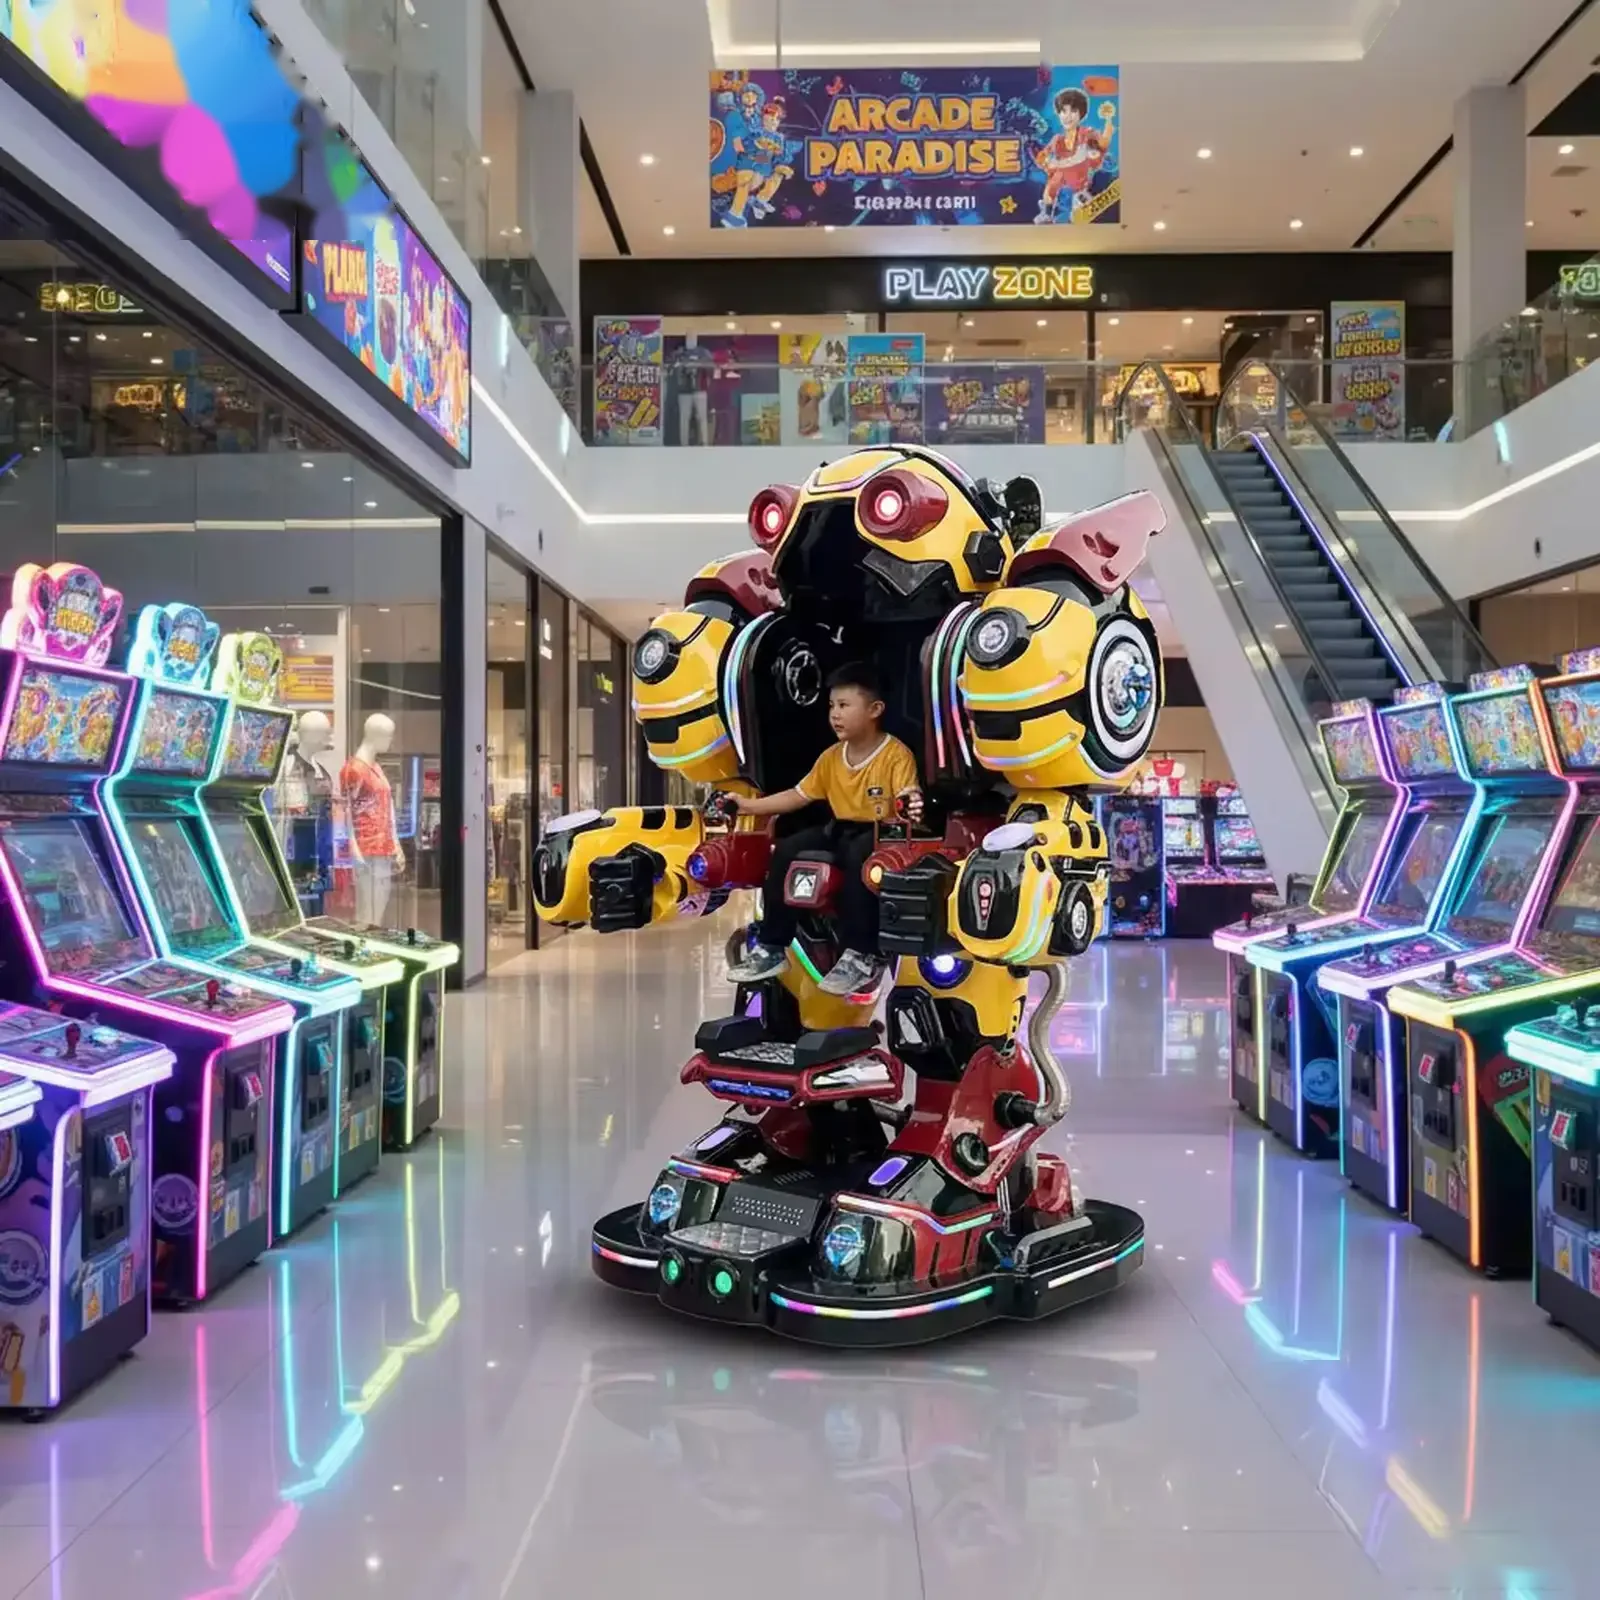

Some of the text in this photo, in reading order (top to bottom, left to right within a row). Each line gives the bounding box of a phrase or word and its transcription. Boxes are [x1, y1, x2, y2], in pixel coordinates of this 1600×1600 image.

[827, 96, 996, 133] ARCADE
[808, 138, 1022, 176] PARADISE
[886, 266, 1093, 300] PLAY ZONE
